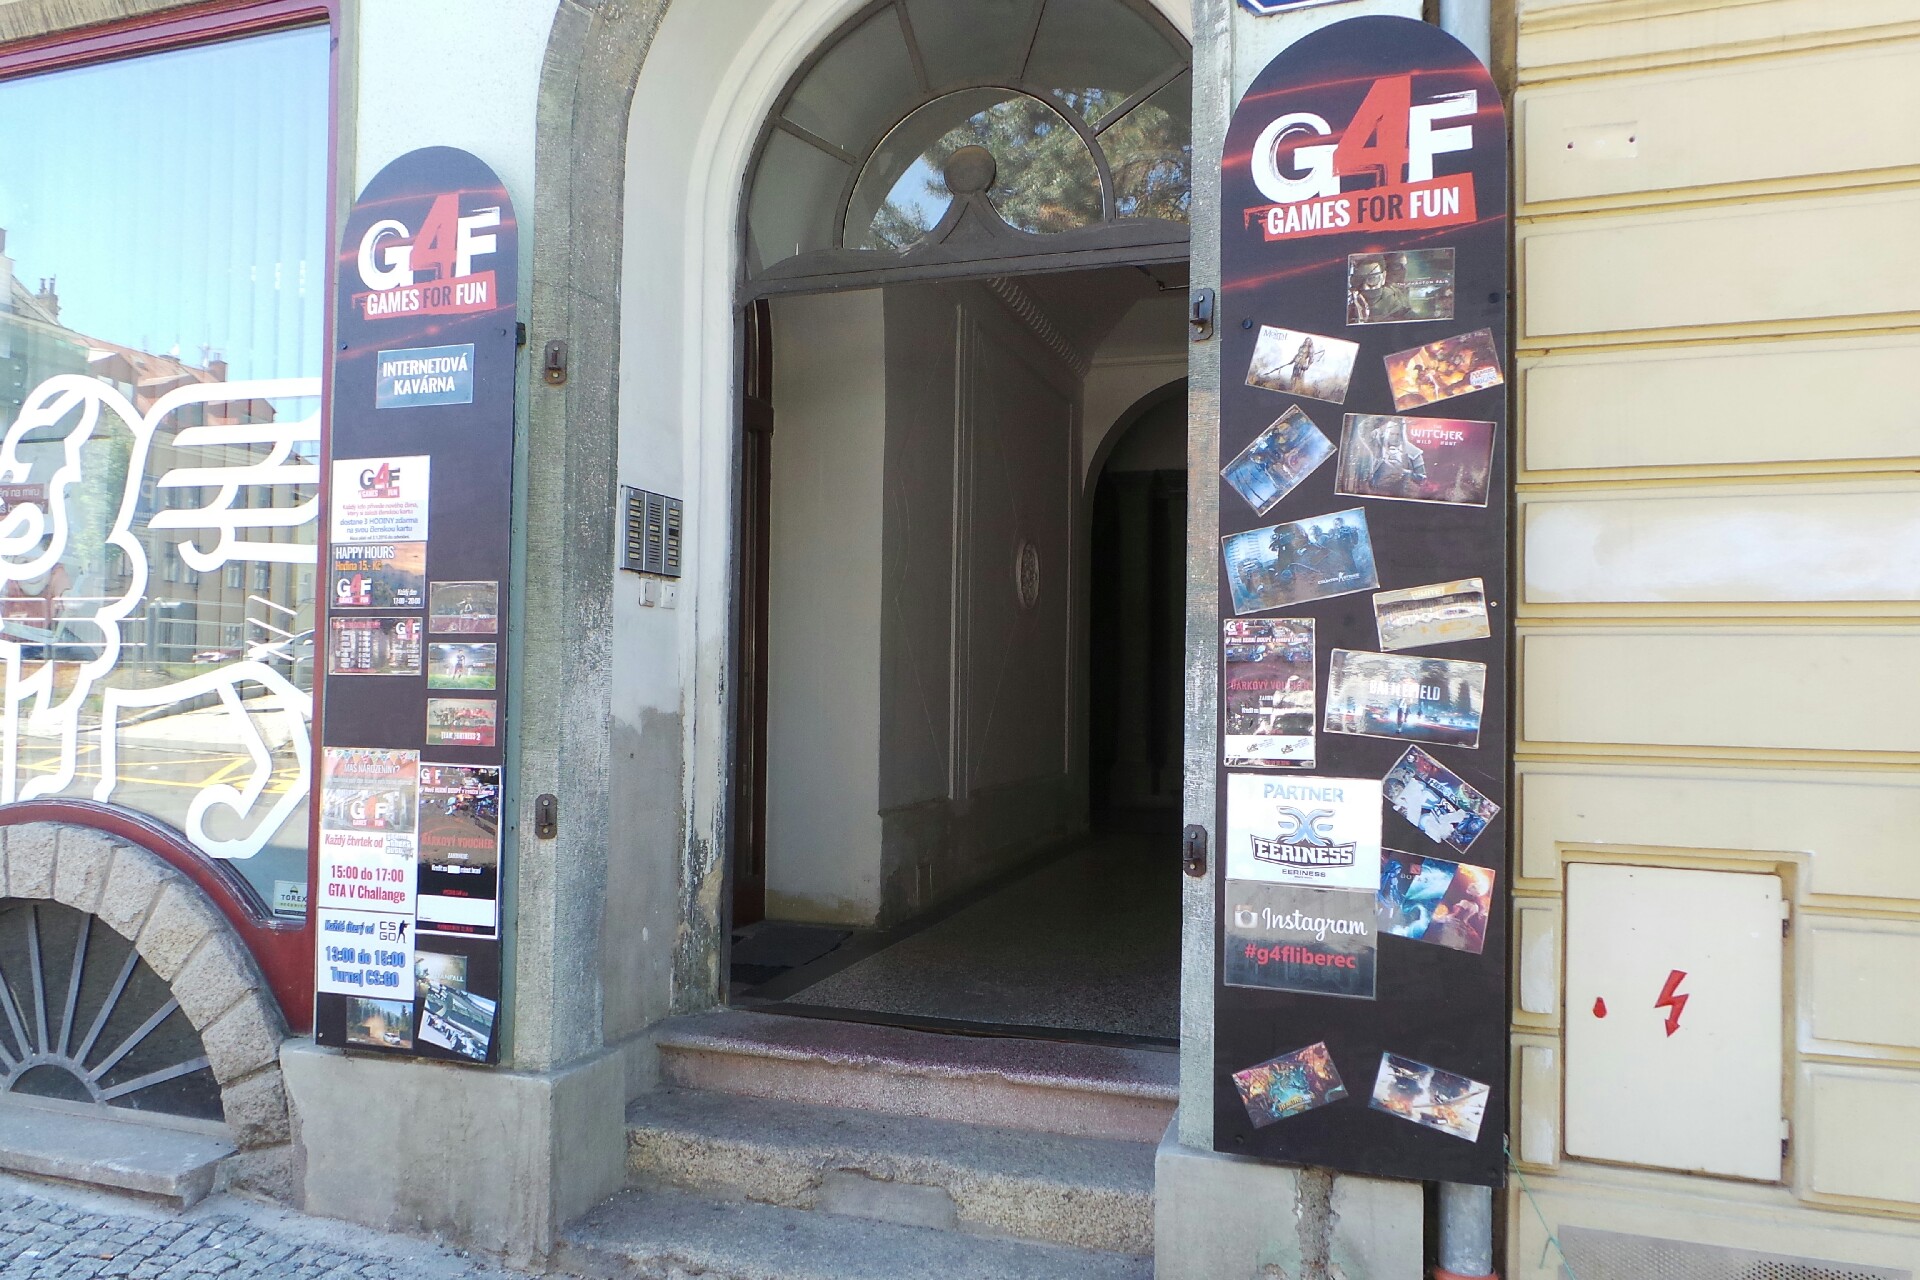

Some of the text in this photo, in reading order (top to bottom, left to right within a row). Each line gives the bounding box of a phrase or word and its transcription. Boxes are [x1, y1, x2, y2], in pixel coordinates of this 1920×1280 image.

[1251, 74, 1477, 203] G4F
[1267, 187, 1459, 234] GAMES FOR FUN
[358, 192, 500, 290] G4F
[367, 281, 486, 316] GAMES FOR FUN
[383, 353, 468, 377] INTERNETOVÁ
[393, 376, 455, 396] KAVÁRNA
[1411, 429, 1464, 441] WITCHER
[360, 463, 401, 491] G4F
[336, 546, 394, 559] HAPPY HOURS
[337, 573, 372, 597] G4F
[1264, 783, 1344, 802] PARTNER
[325, 834, 346, 848] Každý
[347, 834, 372, 848] čtvrtek
[374, 837, 384, 848] od
[1255, 839, 1353, 864] EERINESS
[332, 865, 404, 882] 15:00 do 17:00
[1282, 868, 1326, 877] EERINESS
[281, 894, 307, 903] TOREX
[328, 883, 405, 904] GTA V Challange
[380, 921, 396, 930] CS
[1262, 908, 1367, 941] Instagram
[380, 932, 396, 941] GO
[326, 946, 406, 968] 13:00 do 15:00
[1245, 944, 1356, 969] #g4fliberec
[330, 966, 399, 987] Turnaj CS:GO
